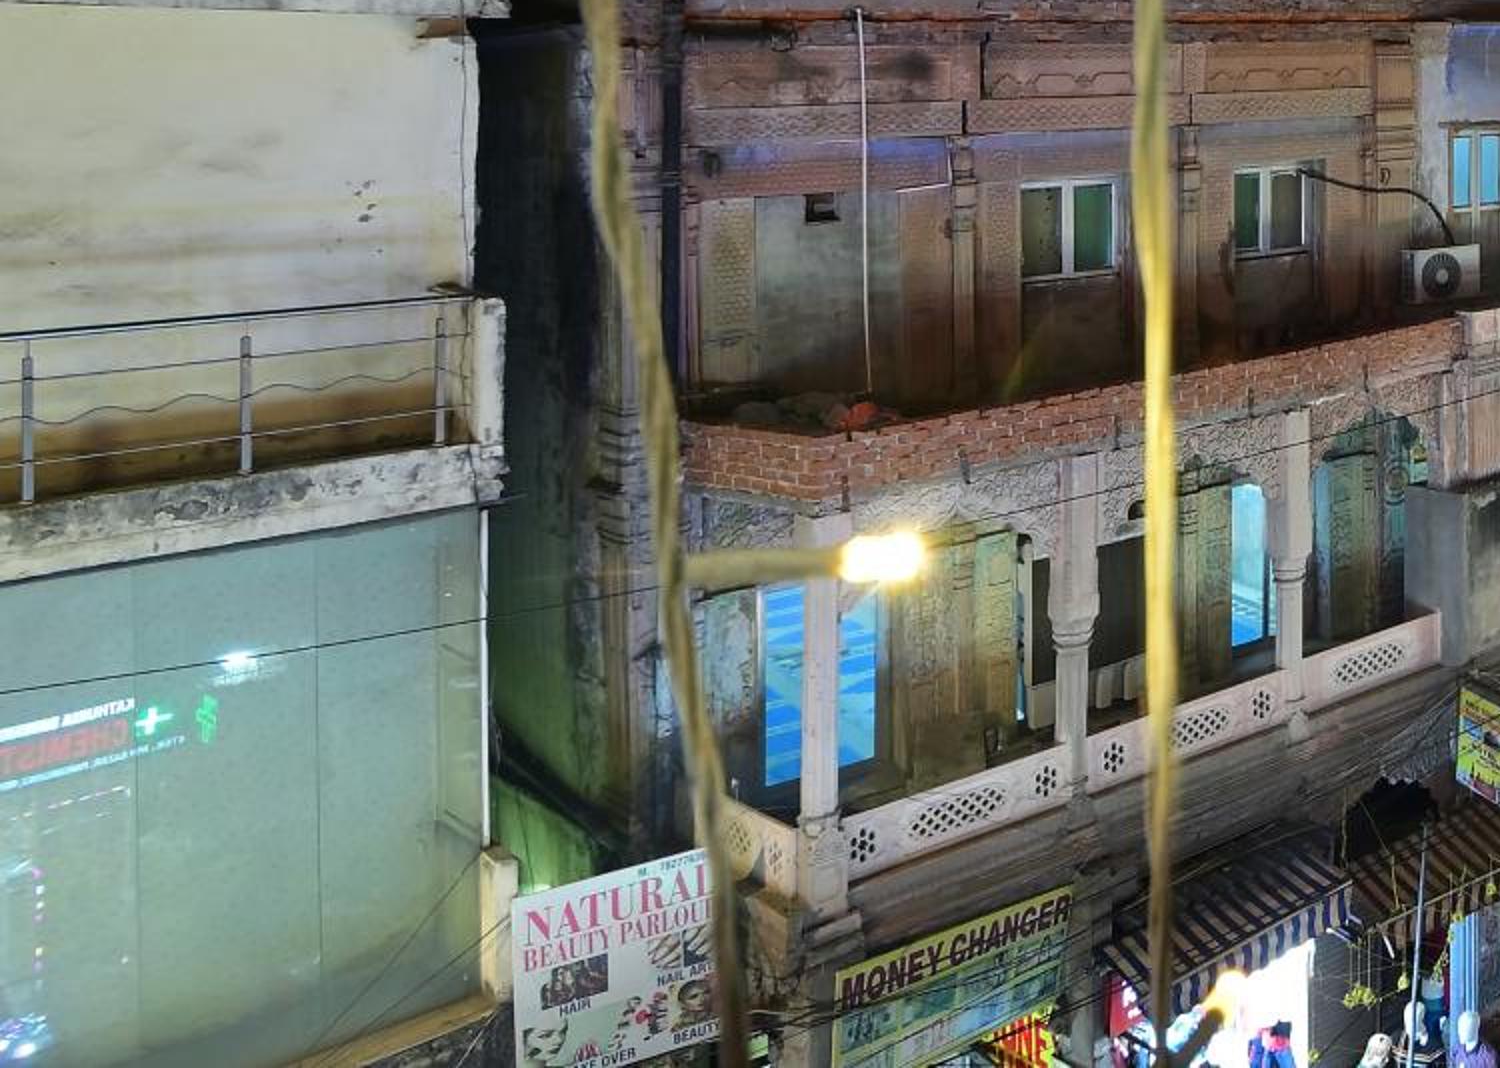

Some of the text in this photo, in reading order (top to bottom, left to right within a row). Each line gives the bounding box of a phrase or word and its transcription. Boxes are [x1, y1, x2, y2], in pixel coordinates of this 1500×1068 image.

[524, 926, 610, 972] BEAUTY
[841, 893, 1073, 1011] MONEY CHANGER
[657, 968, 686, 987] NAIL
[559, 998, 592, 1018] HAIR
[672, 1019, 720, 1045] BEAUTY
[601, 1047, 636, 1068] OVER
